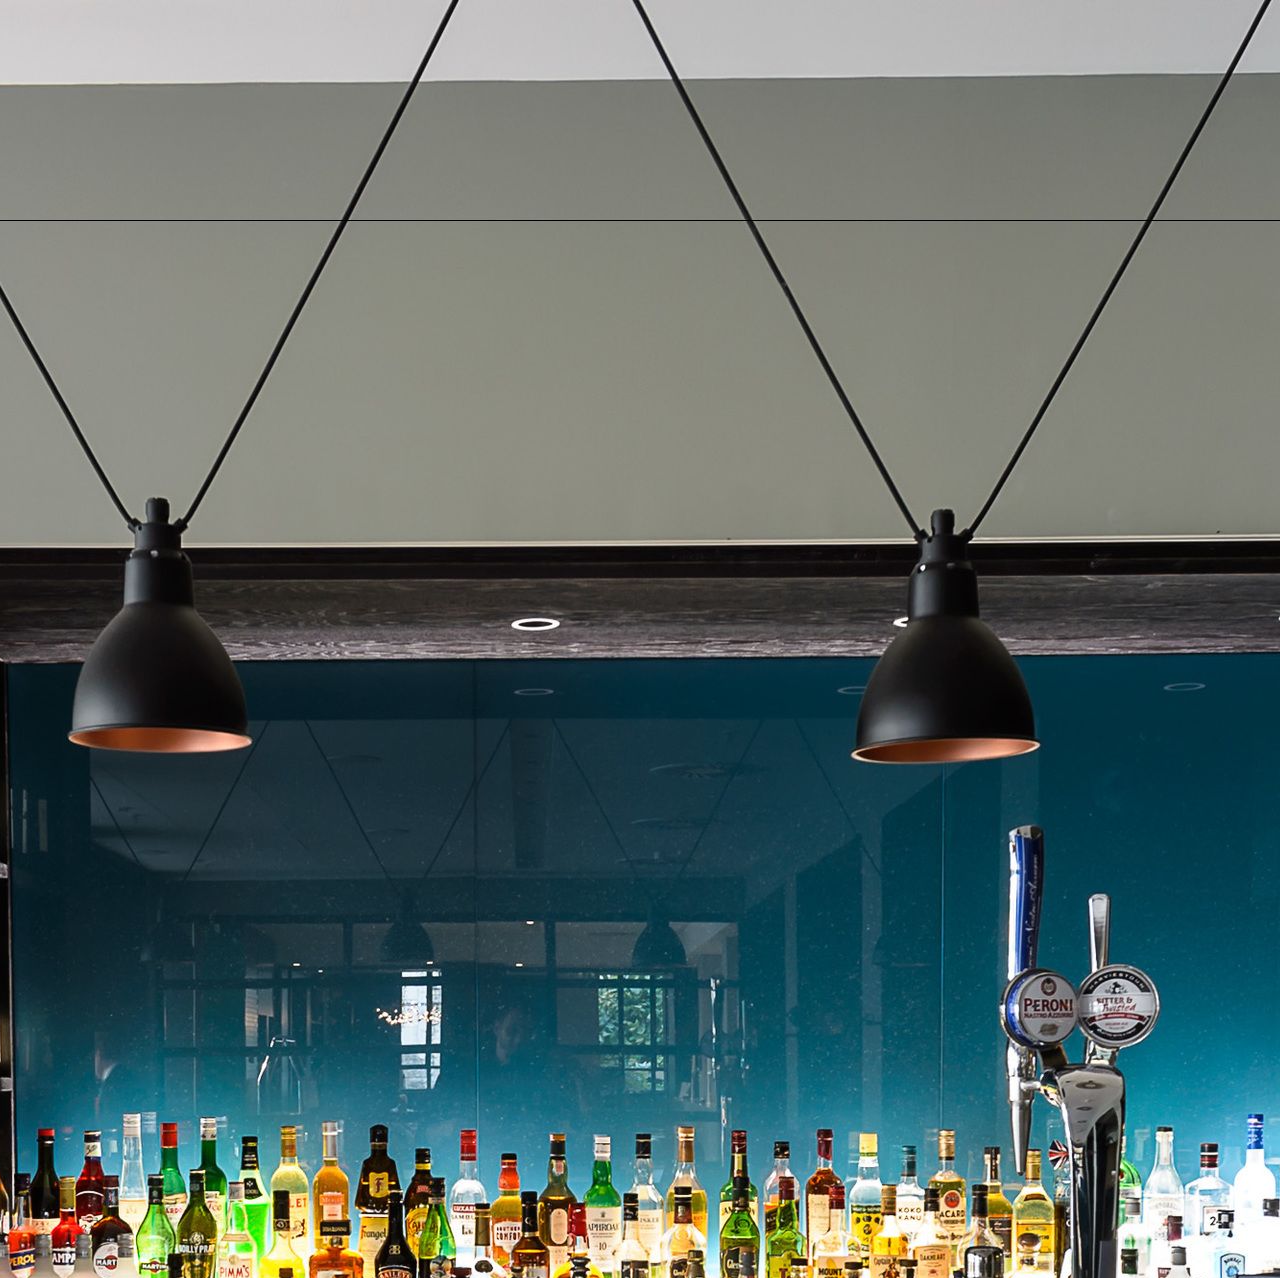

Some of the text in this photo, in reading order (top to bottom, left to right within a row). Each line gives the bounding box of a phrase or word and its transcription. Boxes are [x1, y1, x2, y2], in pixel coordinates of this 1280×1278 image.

[1024, 998, 1073, 1012] PERONI
[360, 1226, 387, 1240] Frangel
[496, 1232, 522, 1240] COMFOR
[598, 1242, 606, 1250] 10
[10, 1254, 36, 1266] PEROL
[220, 1264, 250, 1278] PIMM'S
